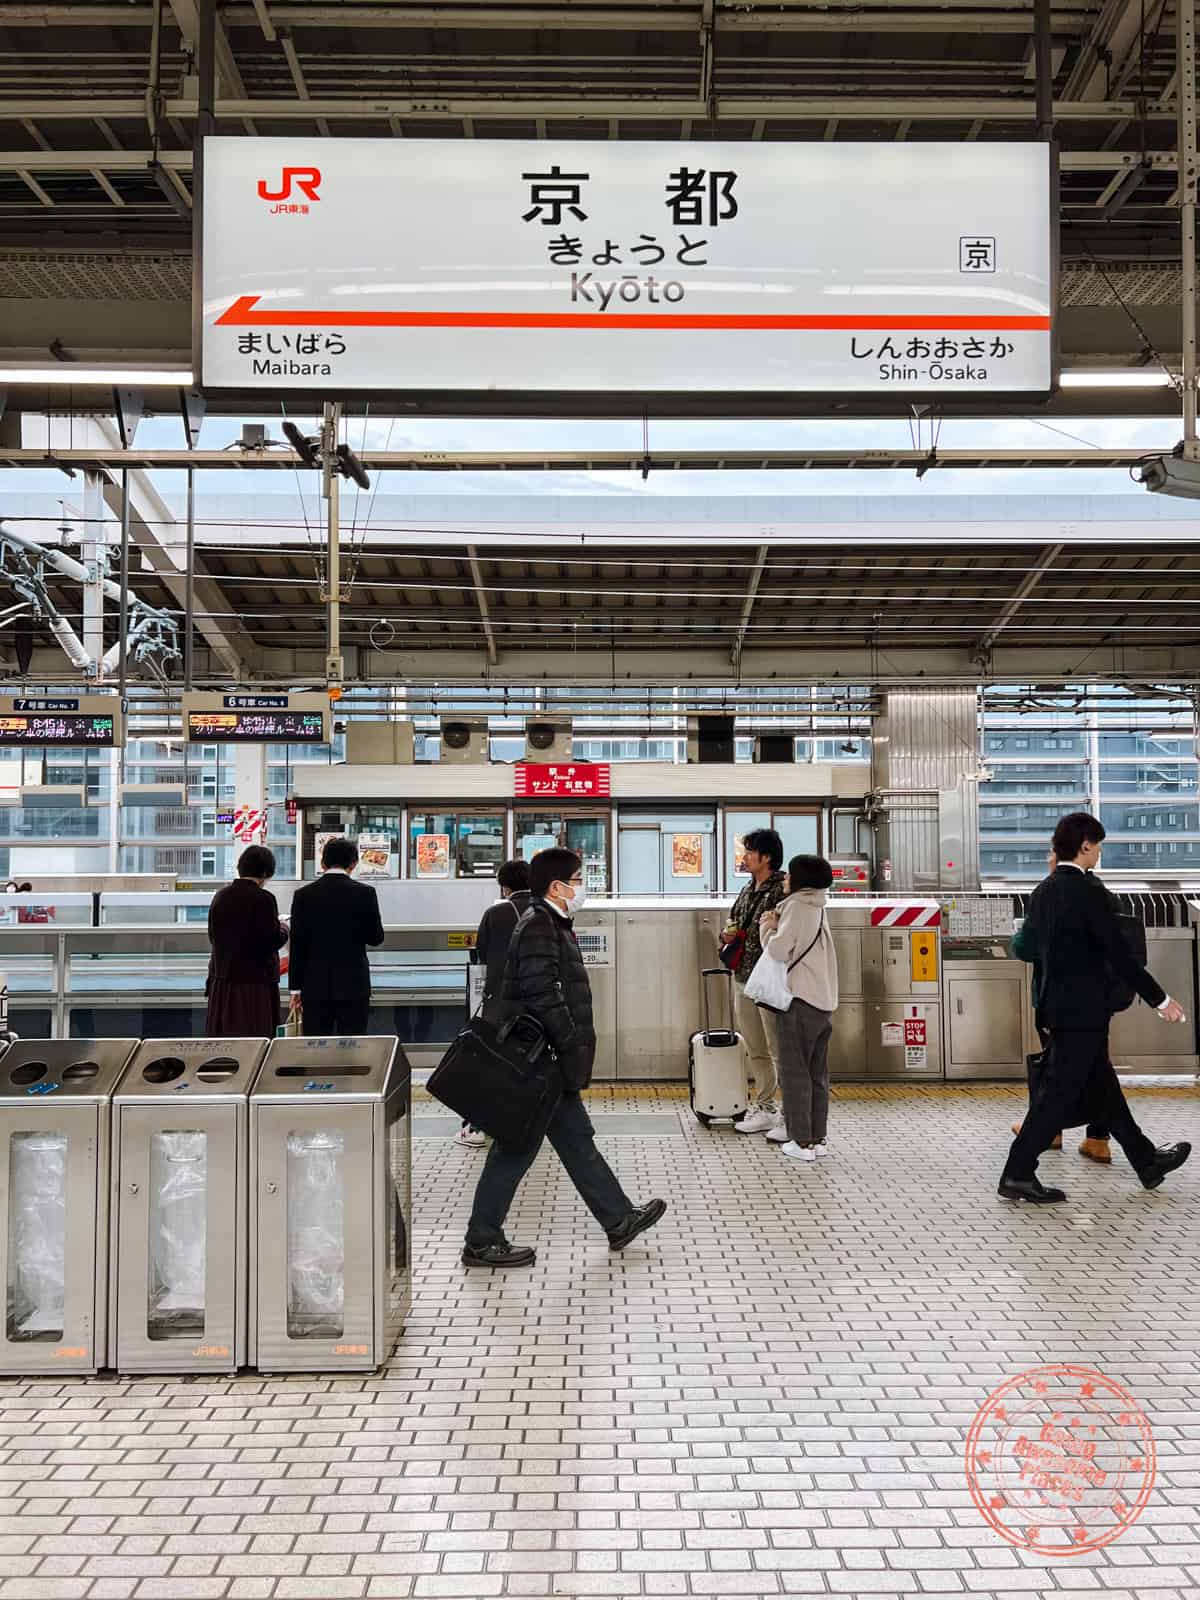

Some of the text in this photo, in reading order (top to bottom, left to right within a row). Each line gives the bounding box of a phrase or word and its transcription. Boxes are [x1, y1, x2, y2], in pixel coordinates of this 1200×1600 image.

[258, 168, 321, 201] JR
[522, 166, 738, 226] 京都
[548, 234, 707, 265] きょうと
[965, 241, 991, 269] 京
[571, 272, 685, 312] Kyōto
[237, 331, 346, 355] まいばら
[850, 336, 1015, 359] しんおおさか
[253, 359, 331, 376] Maibara
[879, 361, 988, 381] Shin-Ōsaka
[906, 1022, 925, 1030] STOP
